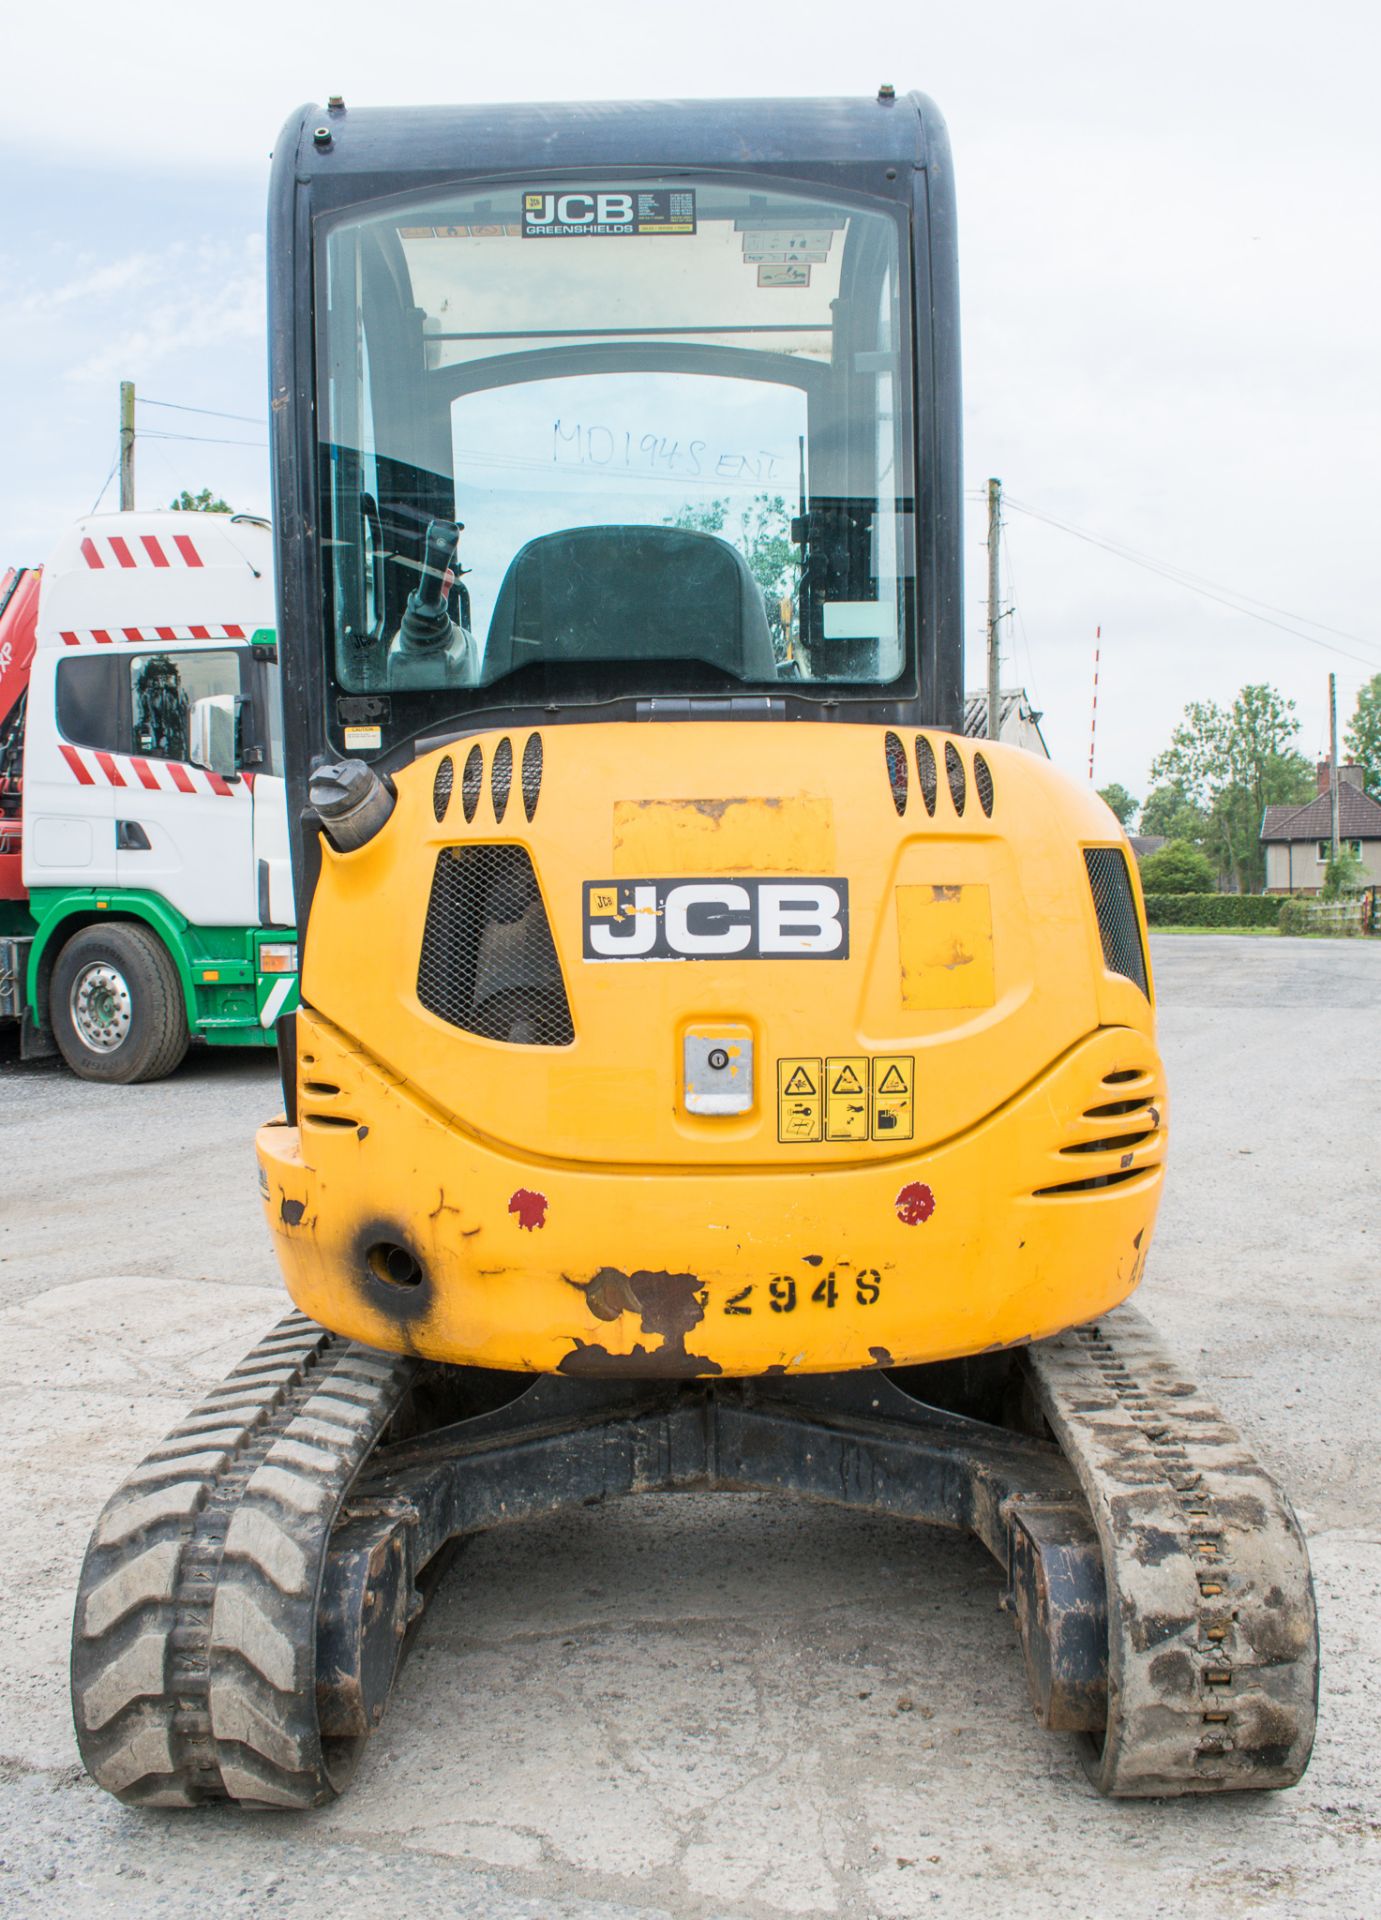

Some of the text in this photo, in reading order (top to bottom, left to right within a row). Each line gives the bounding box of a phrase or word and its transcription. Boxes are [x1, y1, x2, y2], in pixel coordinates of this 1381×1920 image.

[526, 195, 634, 225] JCB
[526, 224, 634, 235] GREENSHIELDS
[590, 884, 843, 955] JCB
